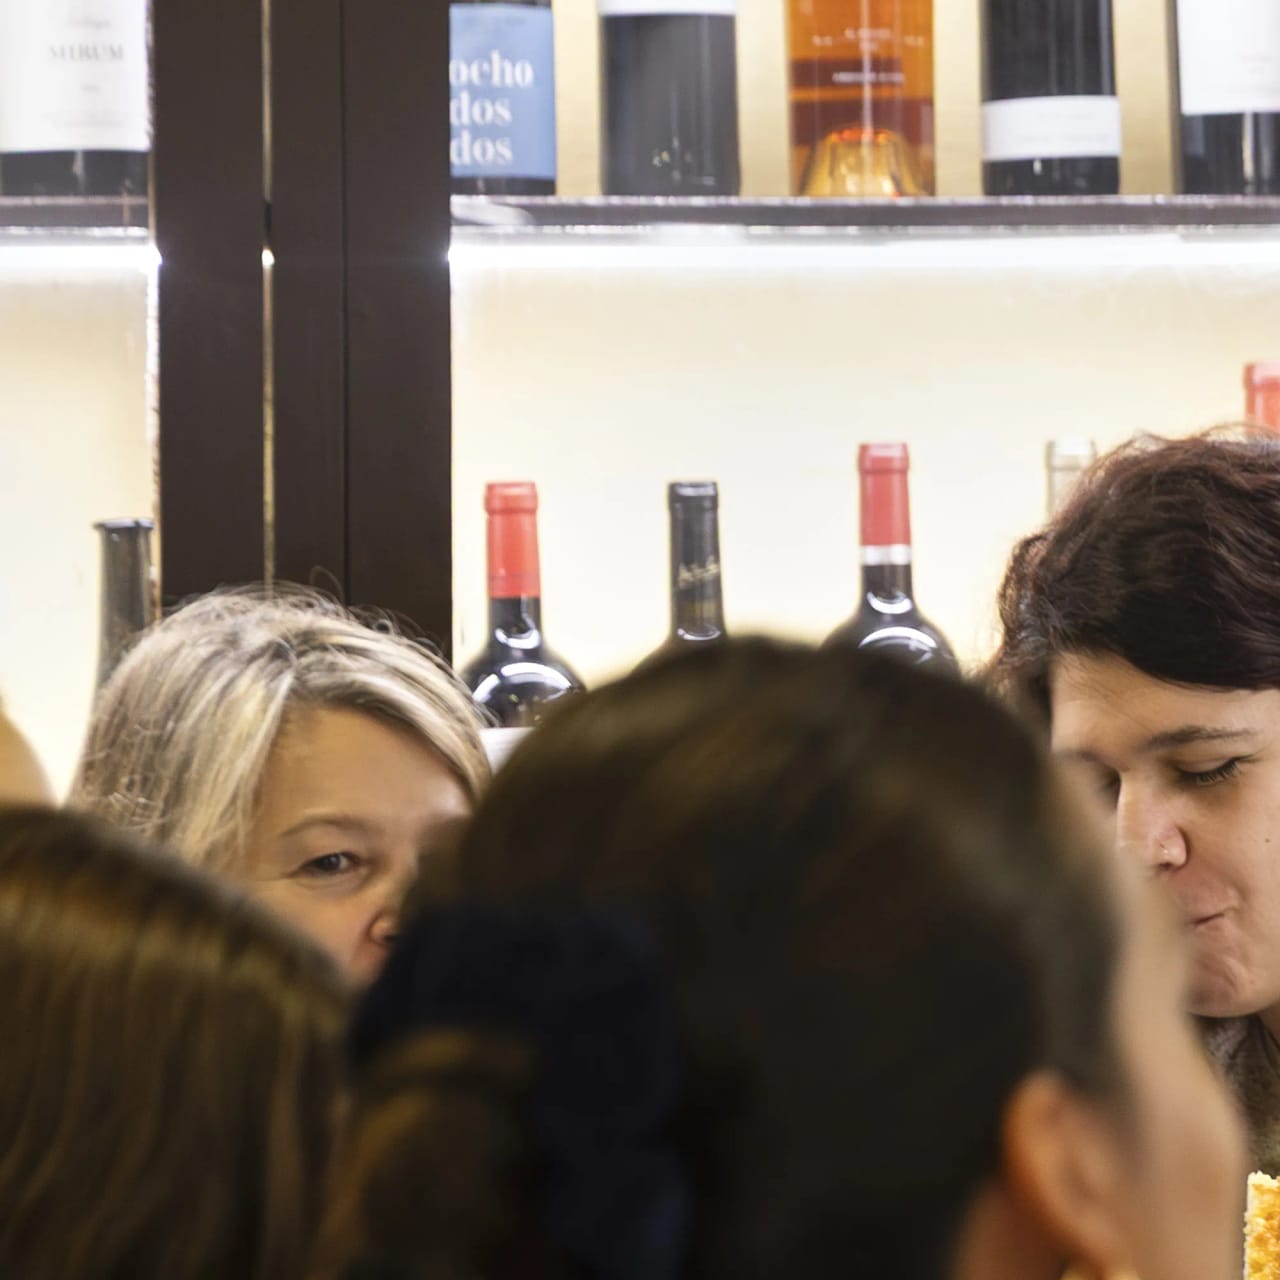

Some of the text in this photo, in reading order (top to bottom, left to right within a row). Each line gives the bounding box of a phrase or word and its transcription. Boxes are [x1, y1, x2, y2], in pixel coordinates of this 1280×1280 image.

[449, 49, 535, 88] ocho
[450, 90, 512, 126] dos
[450, 130, 514, 166] dos
